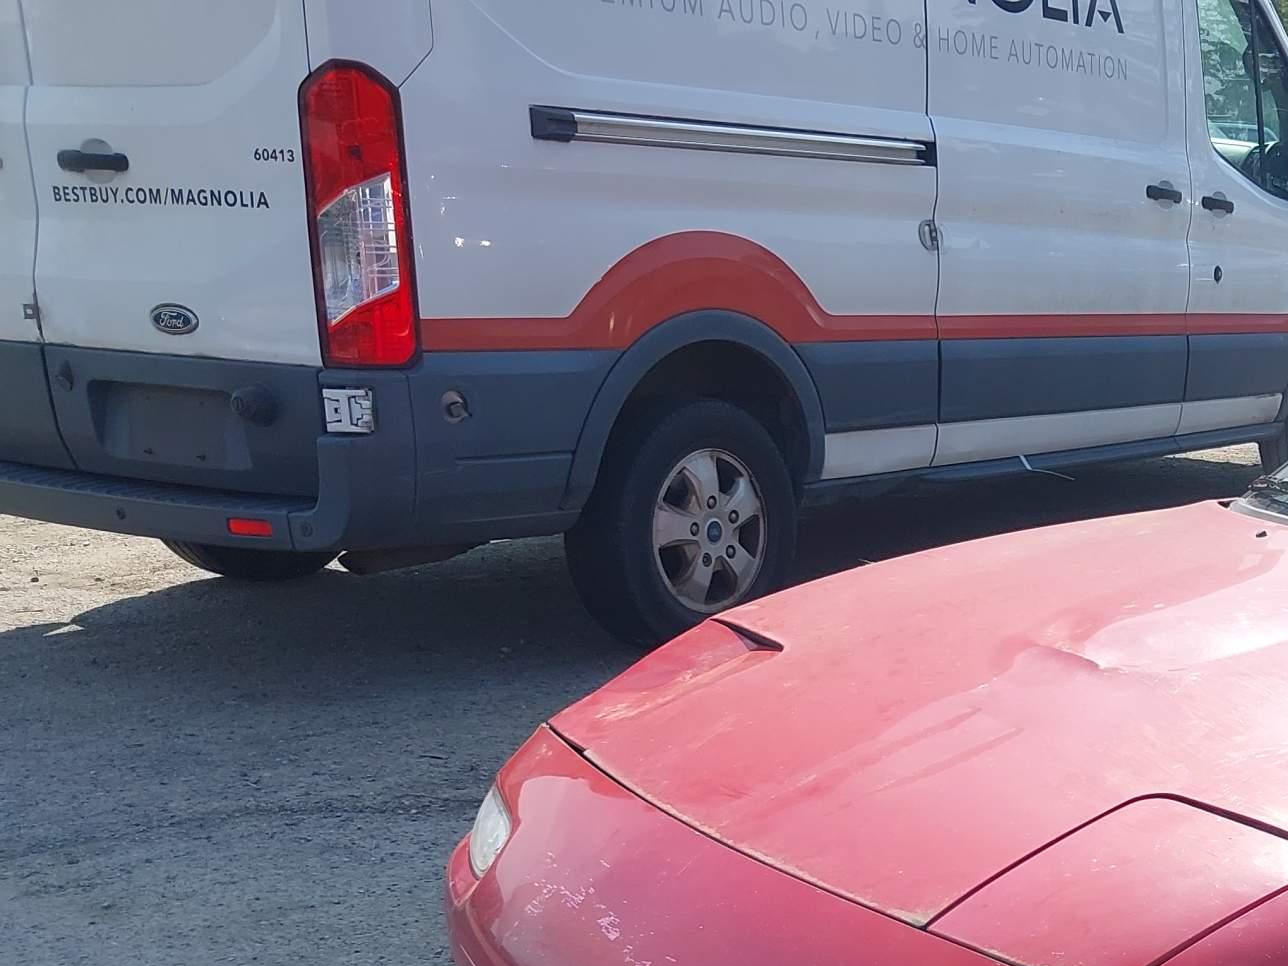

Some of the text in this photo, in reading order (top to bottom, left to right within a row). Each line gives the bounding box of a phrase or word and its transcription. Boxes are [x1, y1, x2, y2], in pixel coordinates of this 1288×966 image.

[826, 8, 902, 45] VIDEO
[913, 22, 927, 49] &
[938, 28, 999, 60] HOME
[1007, 39, 1129, 80] AUTOMATION
[253, 147, 296, 162] 60413
[52, 185, 271, 209] BESTBUY.COM/MAGNOLIA
